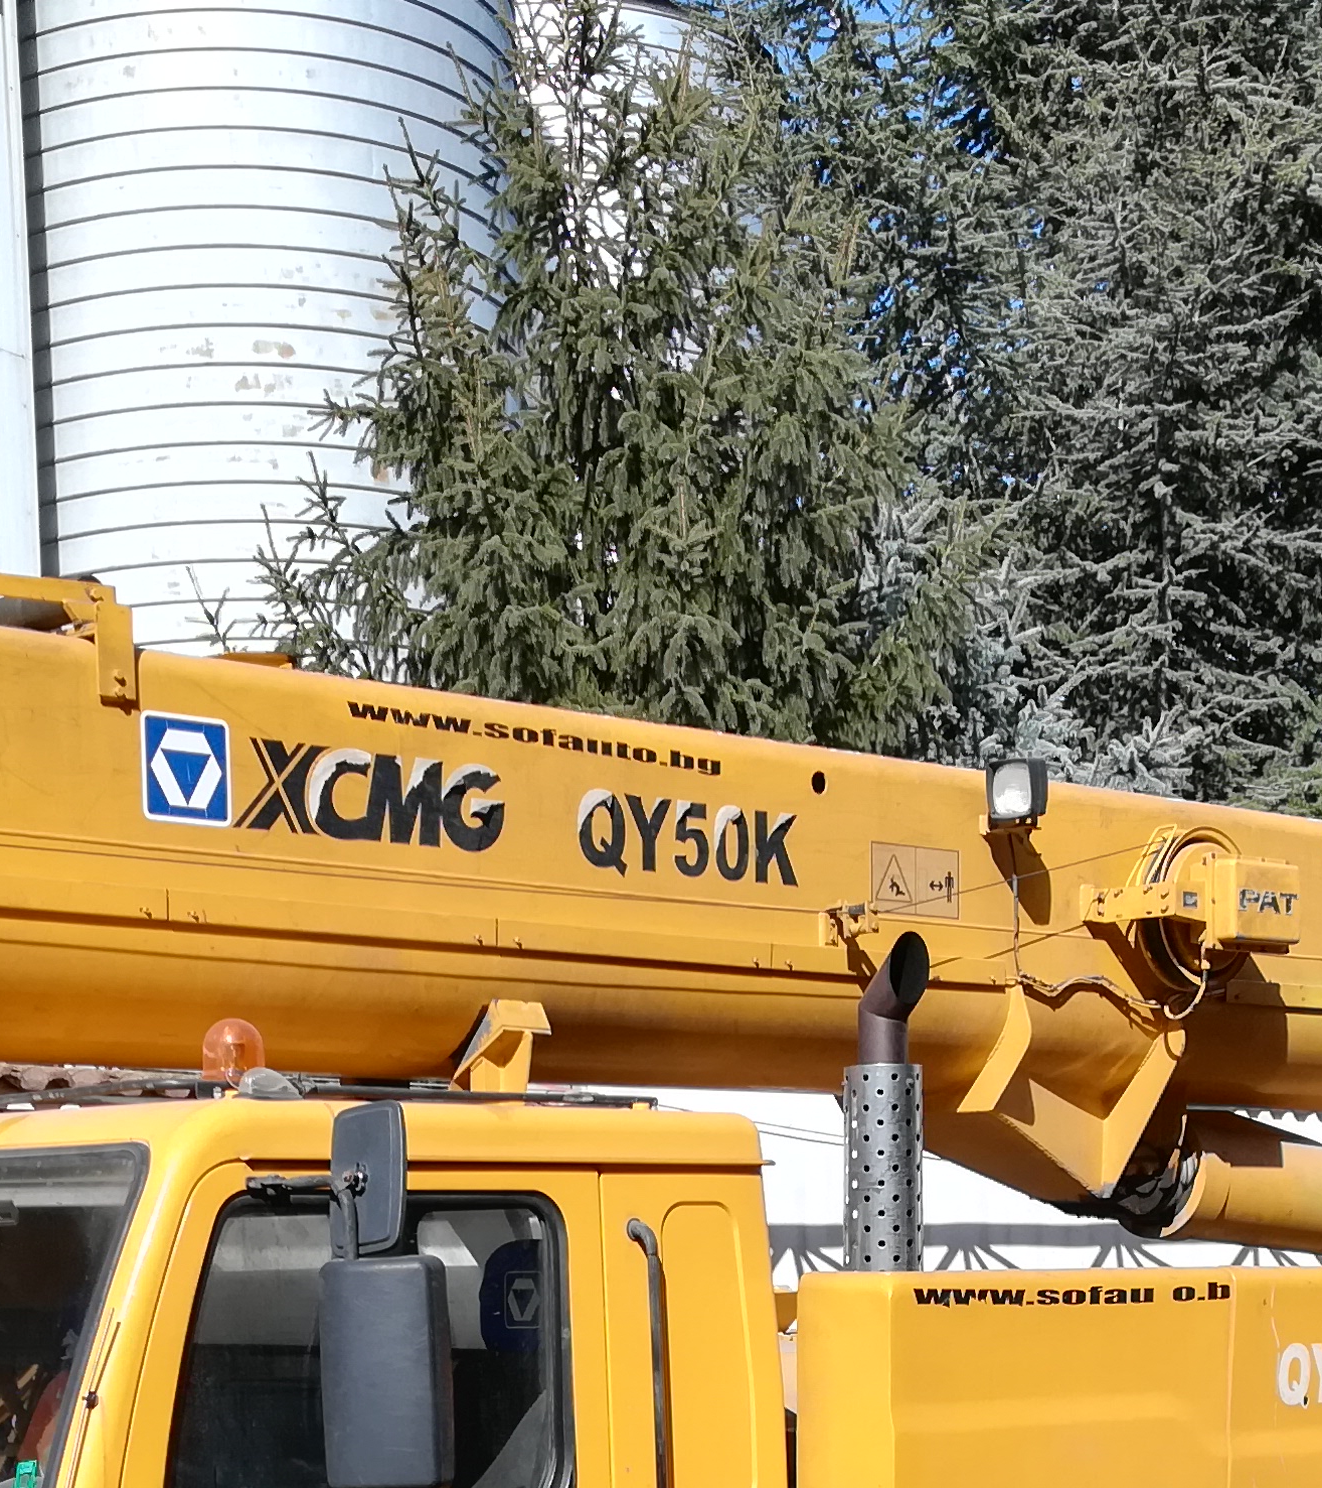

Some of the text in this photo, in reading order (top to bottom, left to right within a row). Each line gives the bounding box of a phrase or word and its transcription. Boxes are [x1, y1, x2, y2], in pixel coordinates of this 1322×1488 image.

[347, 700, 721, 776] www.sofauto.bg
[233, 737, 799, 888] XCMG QY50K
[1238, 889, 1298, 916] PAT
